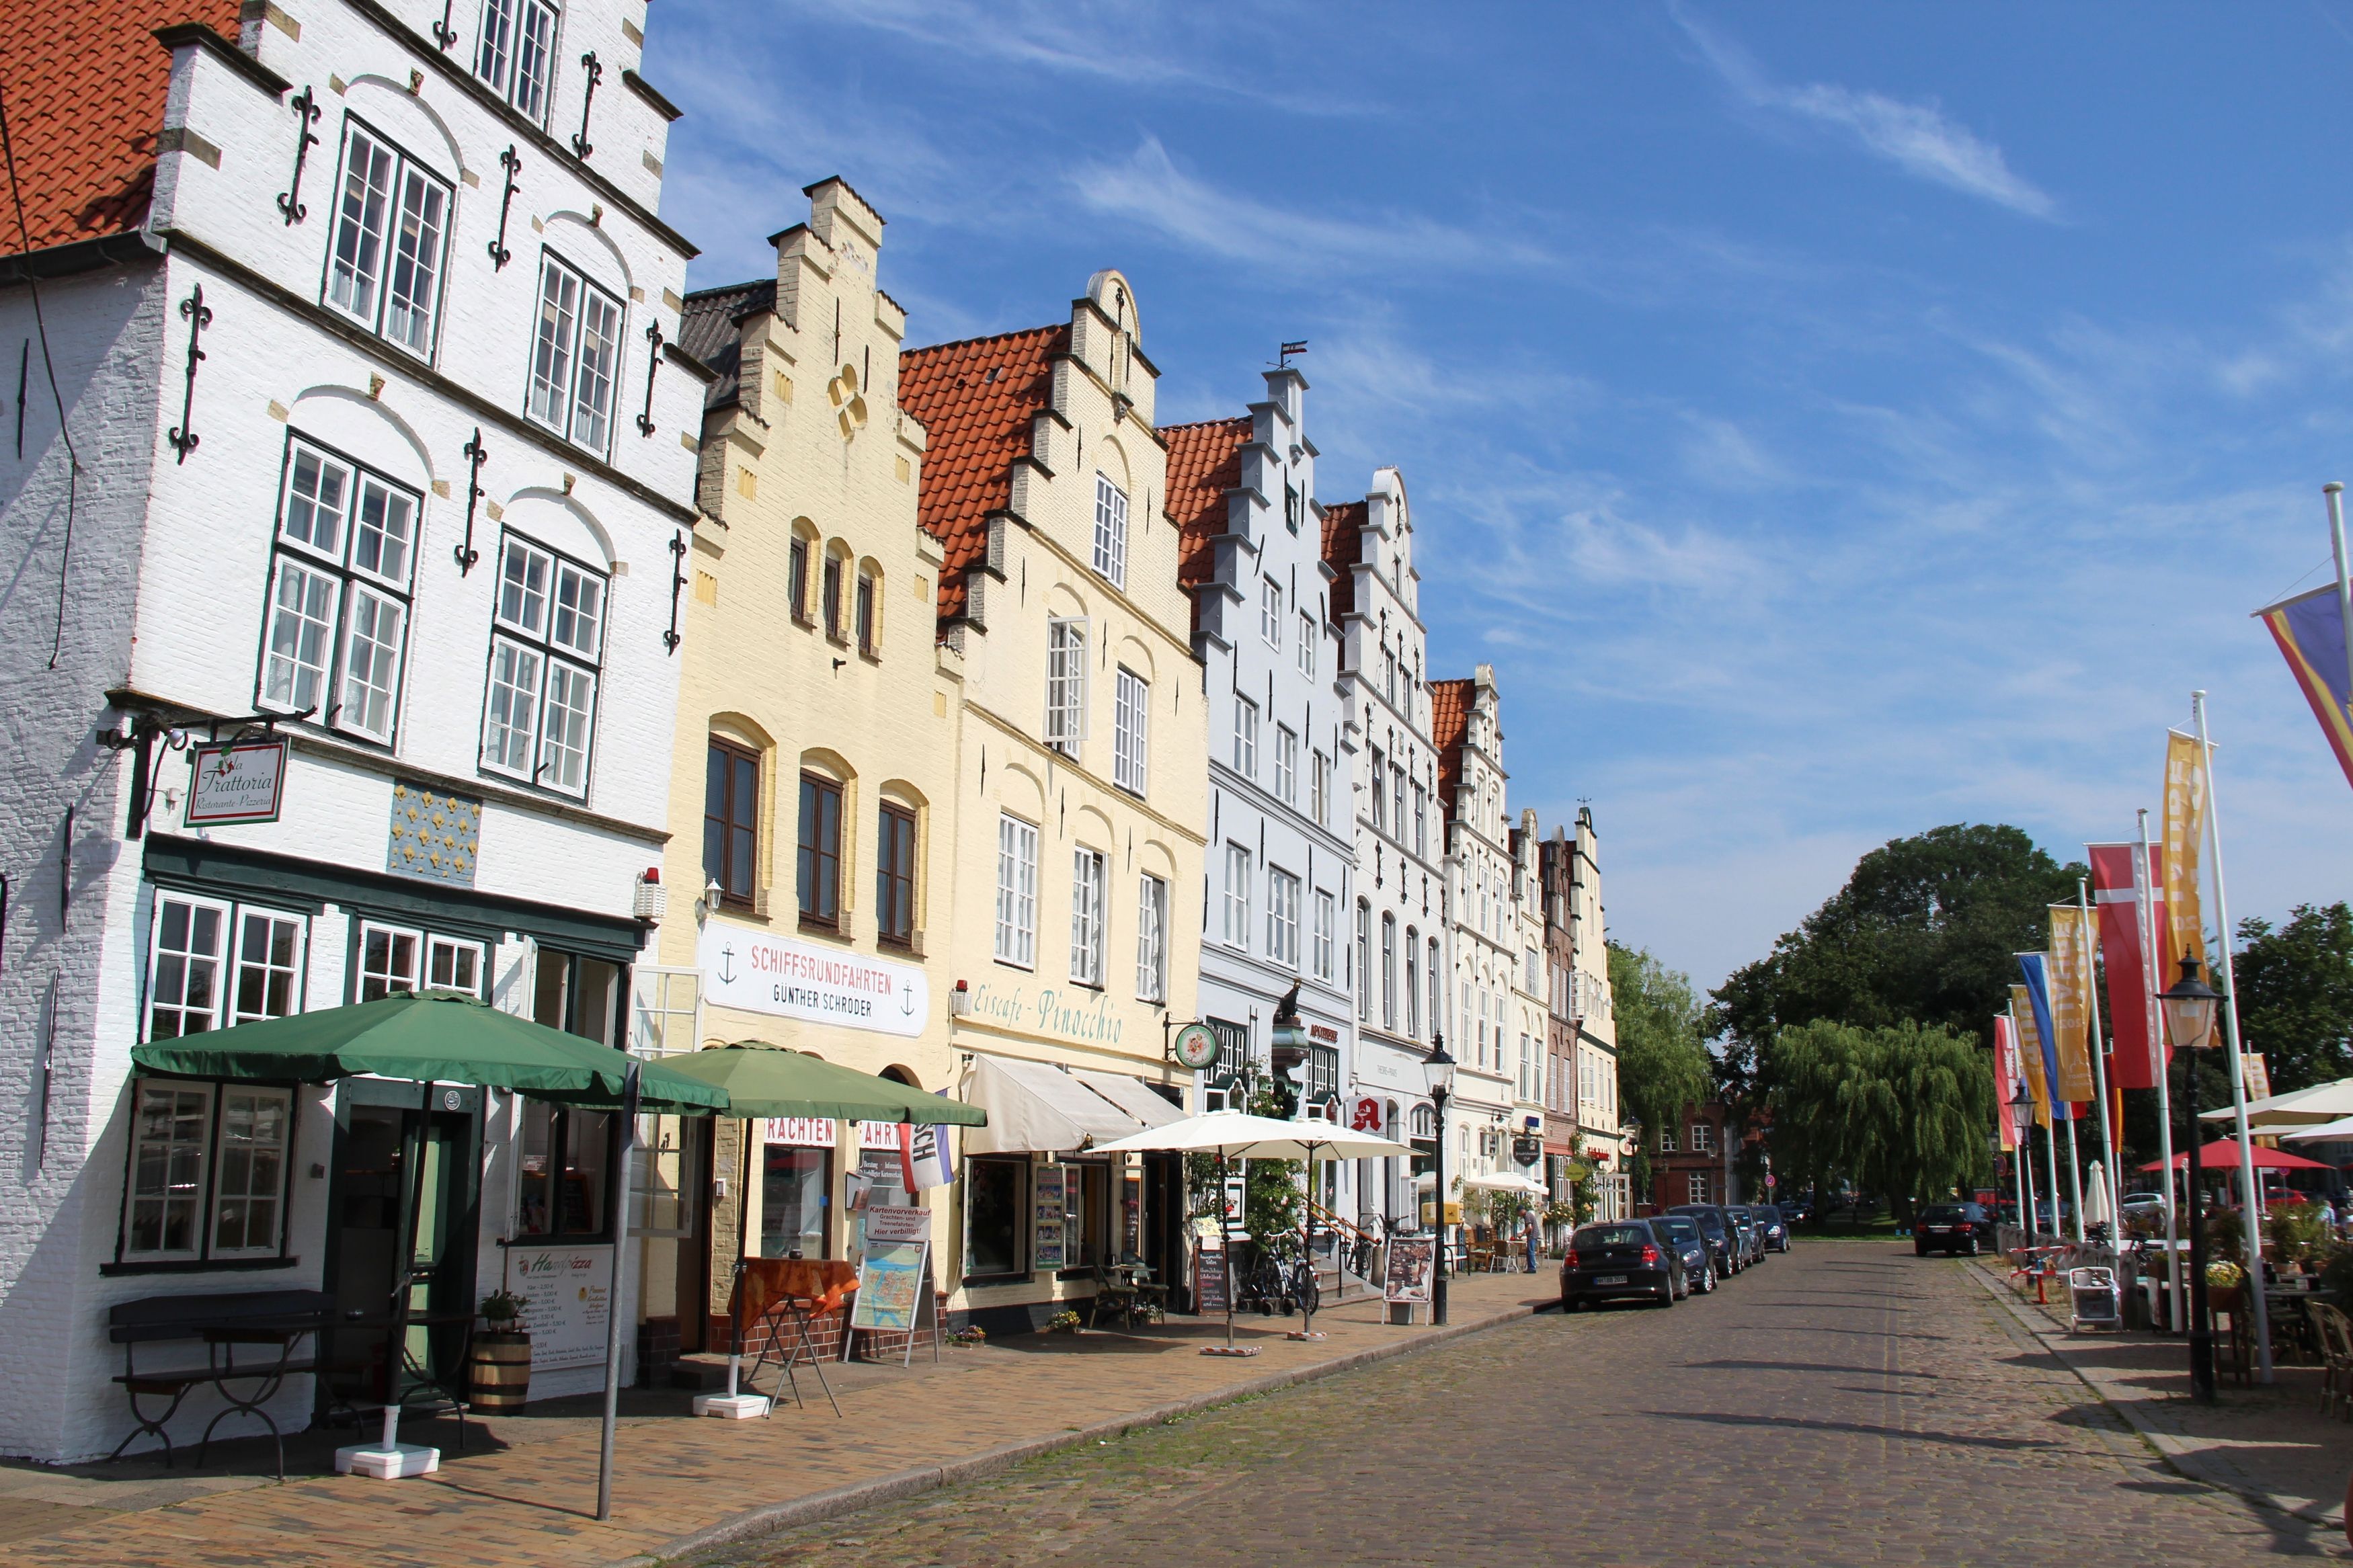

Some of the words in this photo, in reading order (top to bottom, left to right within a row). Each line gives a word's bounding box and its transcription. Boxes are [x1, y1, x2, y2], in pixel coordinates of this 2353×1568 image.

[197, 770, 272, 794] Trattoria
[751, 945, 891, 995] SCHIFFSRUNDFAHRTEN
[774, 982, 819, 1008] GÜNTHER
[823, 993, 872, 1018] SCHRÖDER
[1038, 989, 1122, 1043] Pinocchio
[764, 1117, 832, 1143] RACHTEN
[869, 1206, 931, 1216] Kartenvorverkauf
[890, 1227, 922, 1236] verbilligt!
